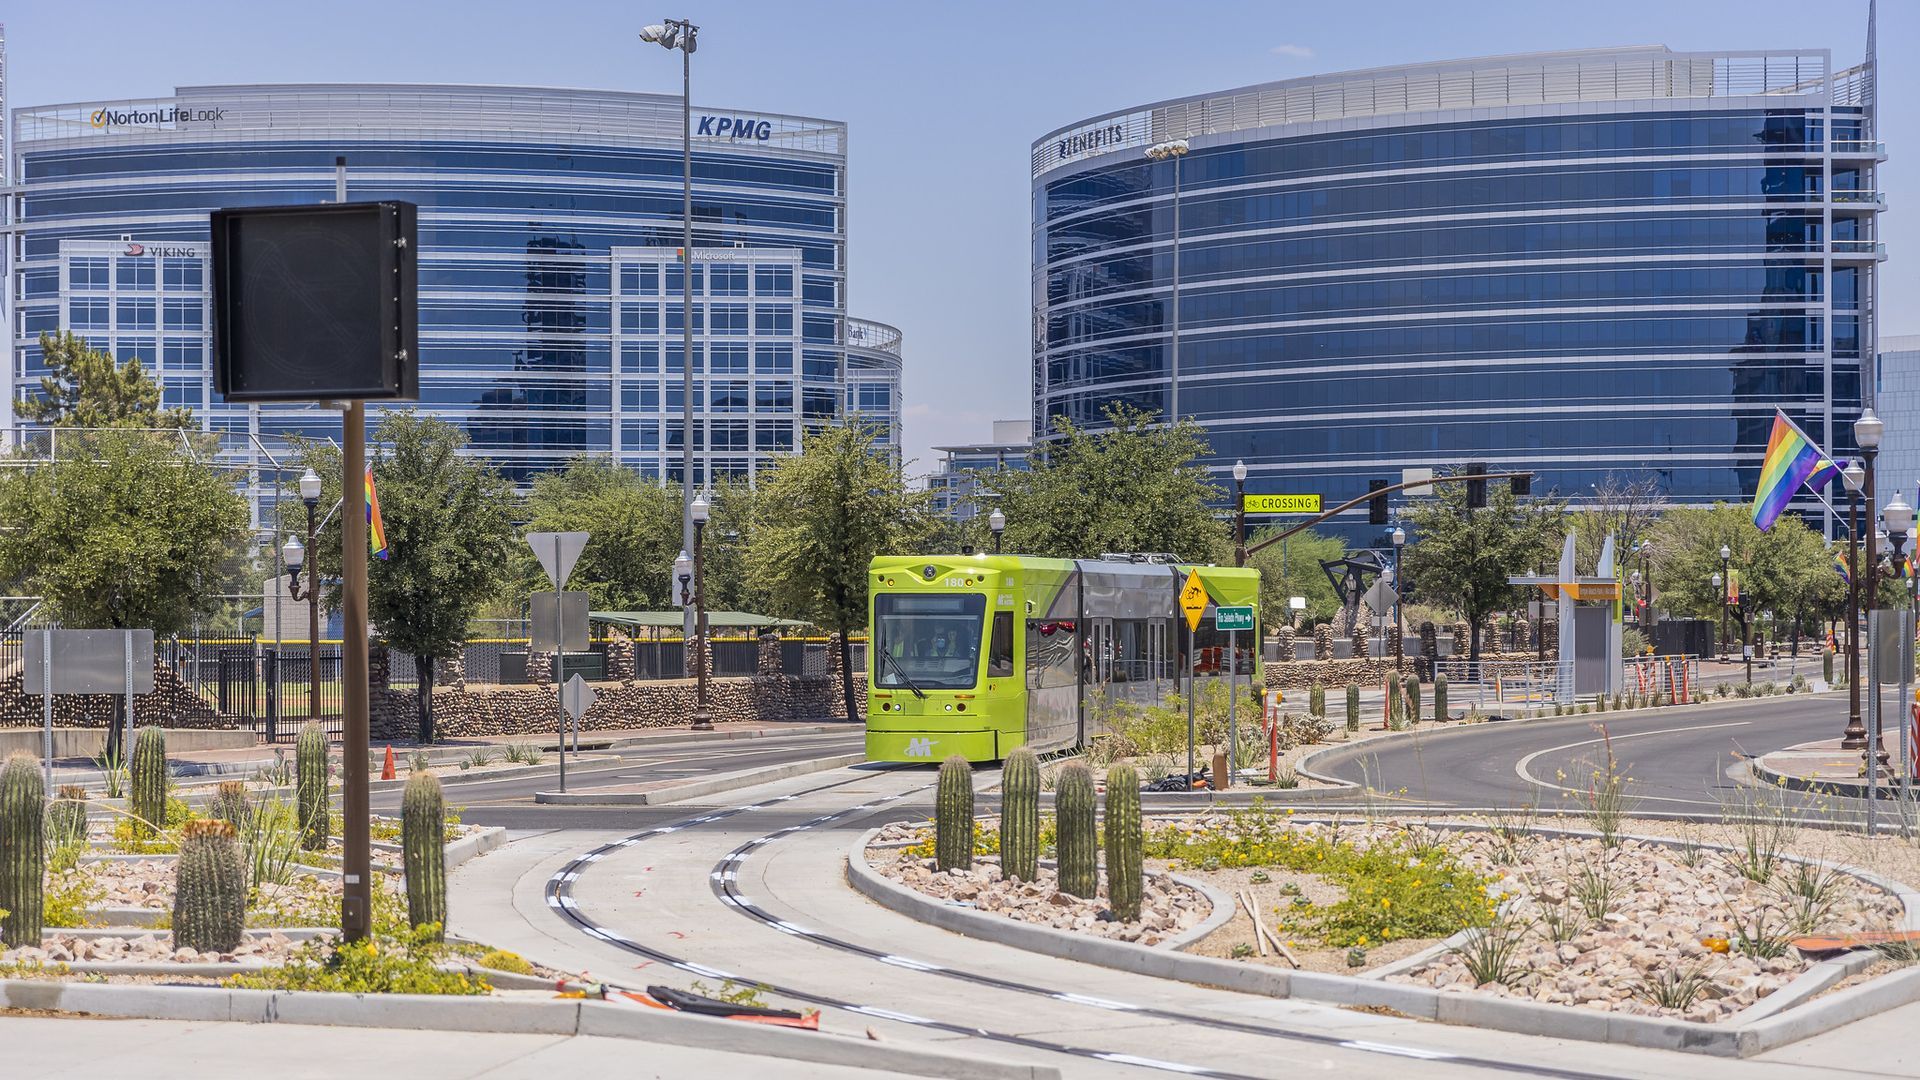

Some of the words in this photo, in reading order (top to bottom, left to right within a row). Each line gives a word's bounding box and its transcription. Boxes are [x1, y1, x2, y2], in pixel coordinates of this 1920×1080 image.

[697, 115, 772, 141] KPMG
[150, 247, 196, 258] VIKING
[693, 251, 736, 261] Microsoft
[1261, 498, 1312, 509] CROSSING
[944, 577, 964, 588] 180
